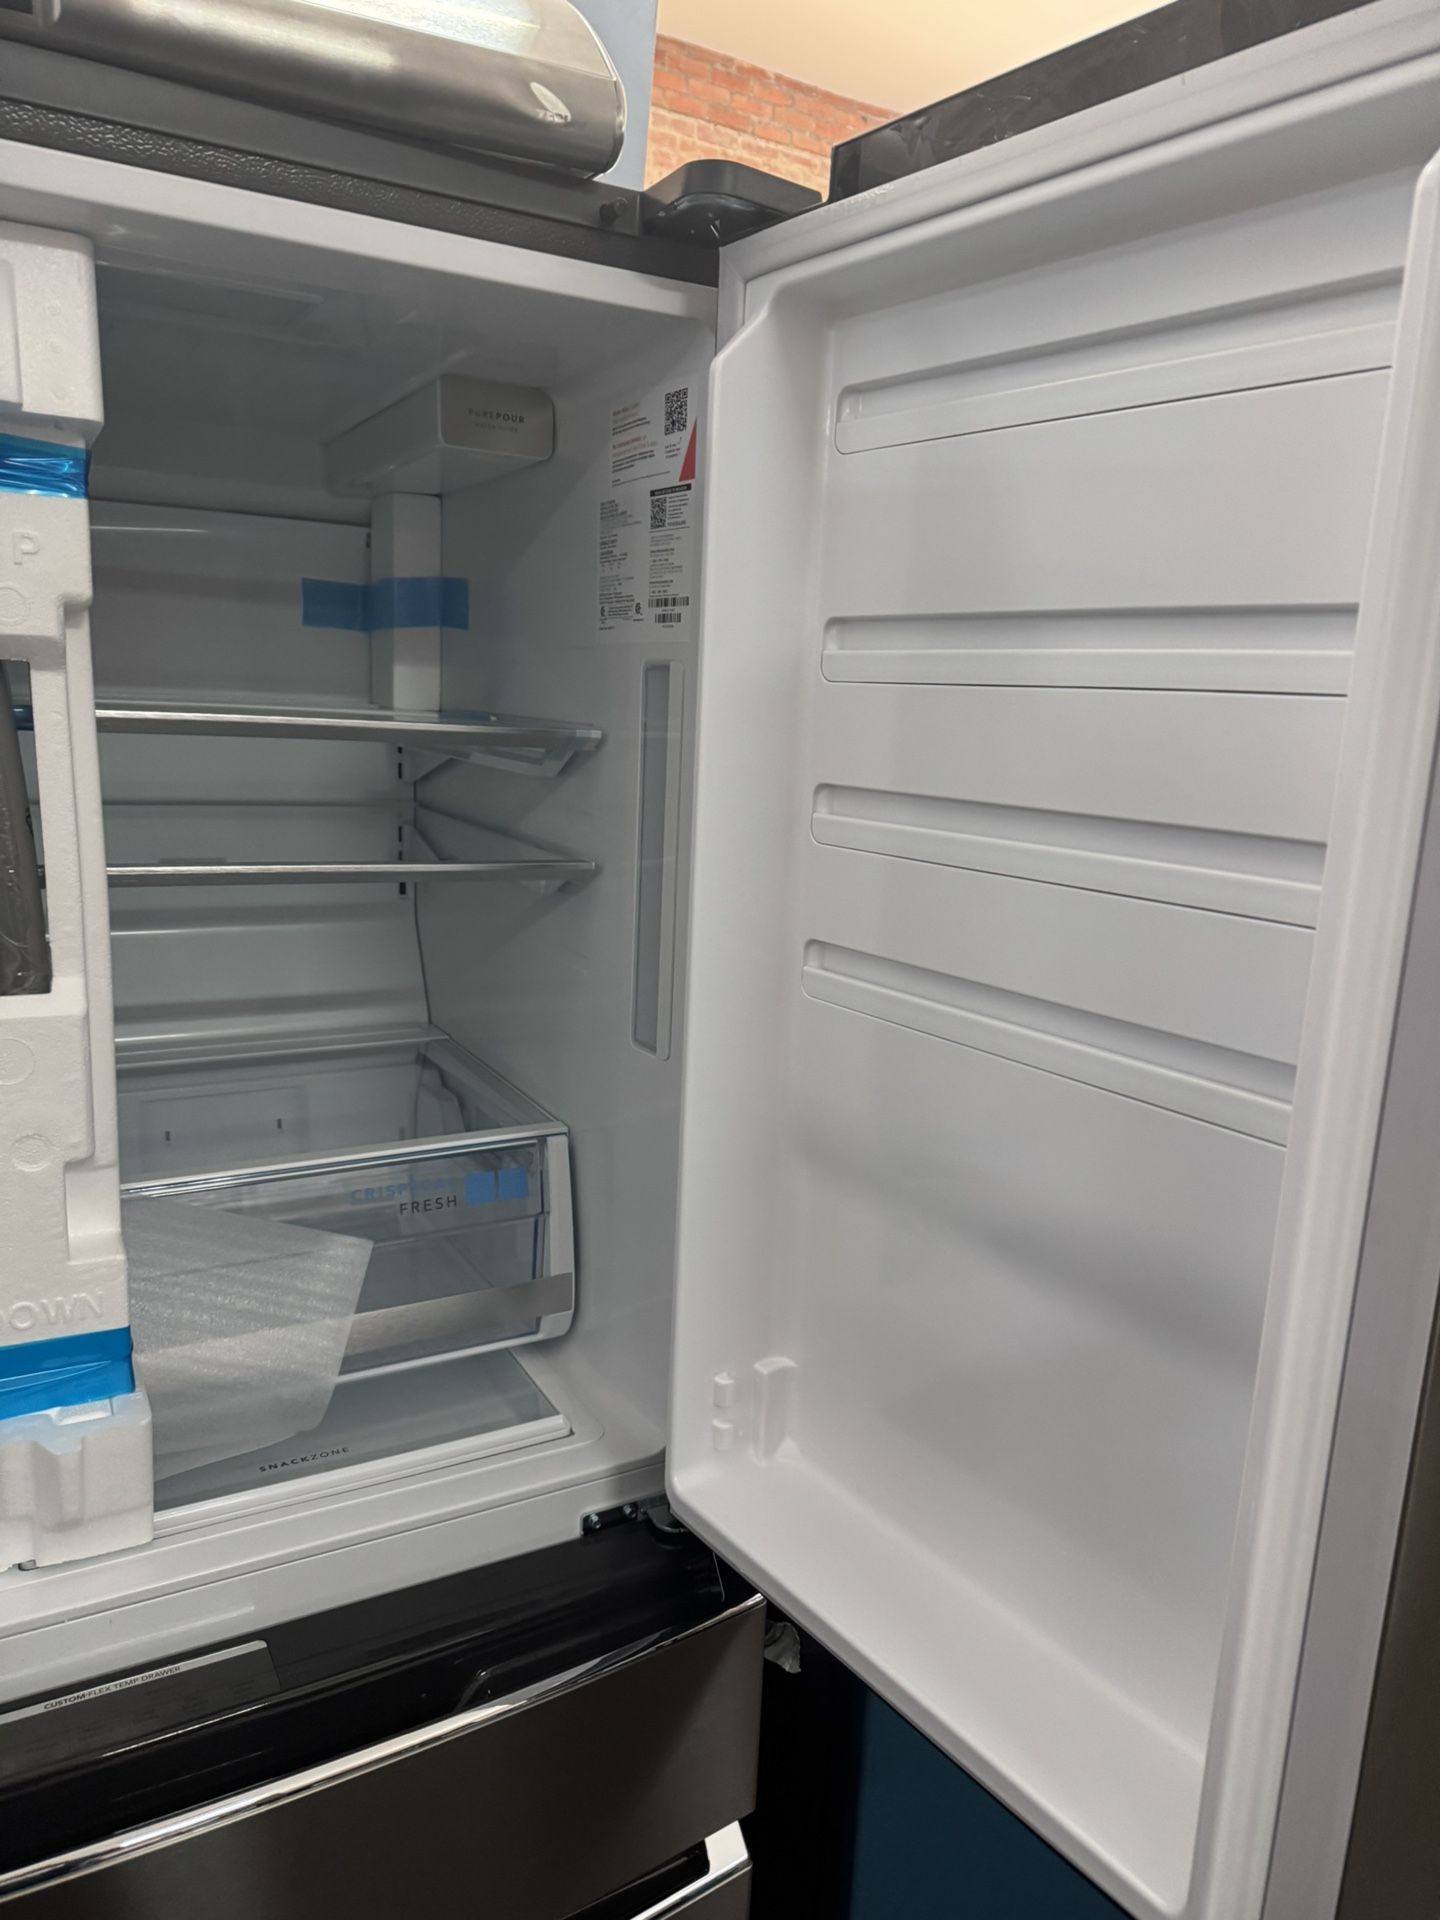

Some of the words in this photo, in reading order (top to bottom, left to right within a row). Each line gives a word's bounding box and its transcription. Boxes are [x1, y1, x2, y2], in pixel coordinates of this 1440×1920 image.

[468, 408, 525, 424] PUREPOUR
[399, 1195, 458, 1216] FRESH
[0, 1289, 103, 1331] OWN
[259, 1447, 350, 1472] SNACKZONE
[114, 1677, 141, 1691] TEMP
[141, 1666, 181, 1682] DRAWER
